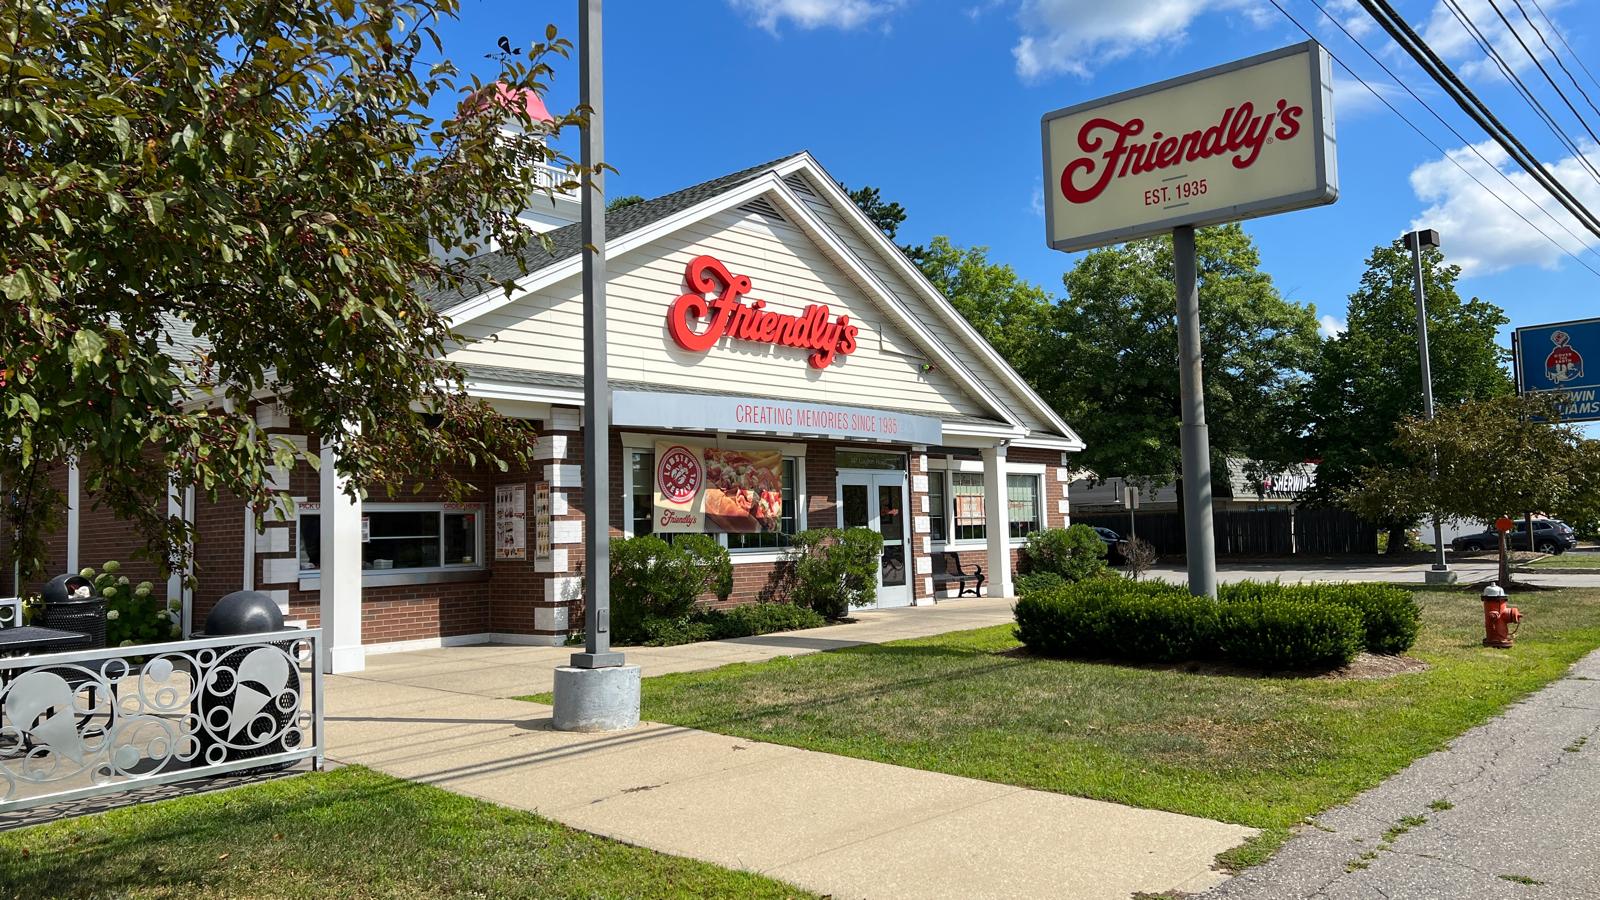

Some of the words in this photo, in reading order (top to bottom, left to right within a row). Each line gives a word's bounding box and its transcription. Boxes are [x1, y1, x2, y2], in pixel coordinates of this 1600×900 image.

[1060, 98, 1303, 204] Friendly's
[1144, 187, 1171, 206] EST.
[1175, 179, 1208, 200] 1935
[667, 255, 859, 369] Friendly's
[735, 404, 793, 426] CREATING
[796, 409, 849, 430] MEMORIES
[851, 414, 876, 432] SINCE
[879, 417, 897, 434] 1935
[664, 454, 694, 476] LOBSTER
